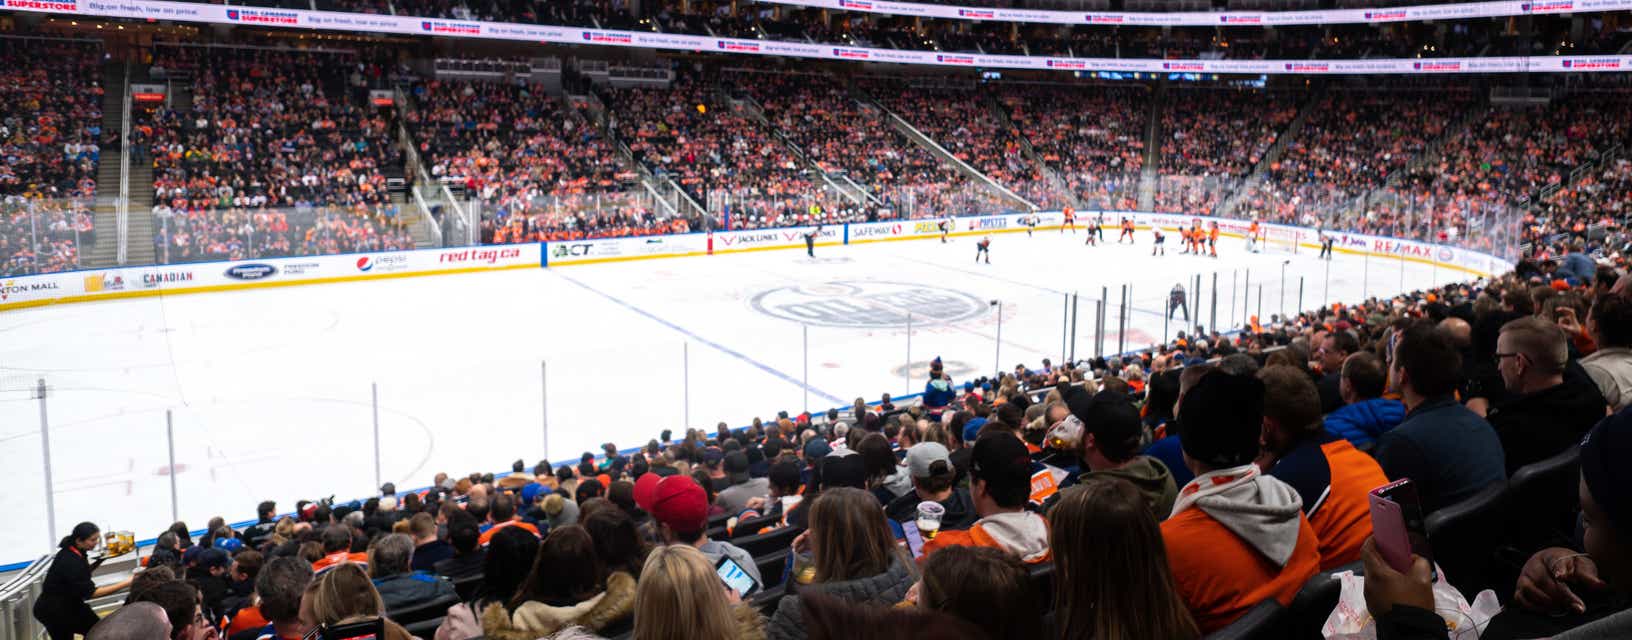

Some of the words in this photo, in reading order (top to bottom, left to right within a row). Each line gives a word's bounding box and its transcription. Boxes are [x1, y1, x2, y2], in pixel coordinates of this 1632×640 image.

[7, 0, 77, 11] SUPERSTORE
[854, 226, 890, 236] SAFEWAY
[1375, 239, 1432, 257] RE/MAX
[143, 272, 192, 283] CANADIAN
[31, 282, 58, 291] MALL
